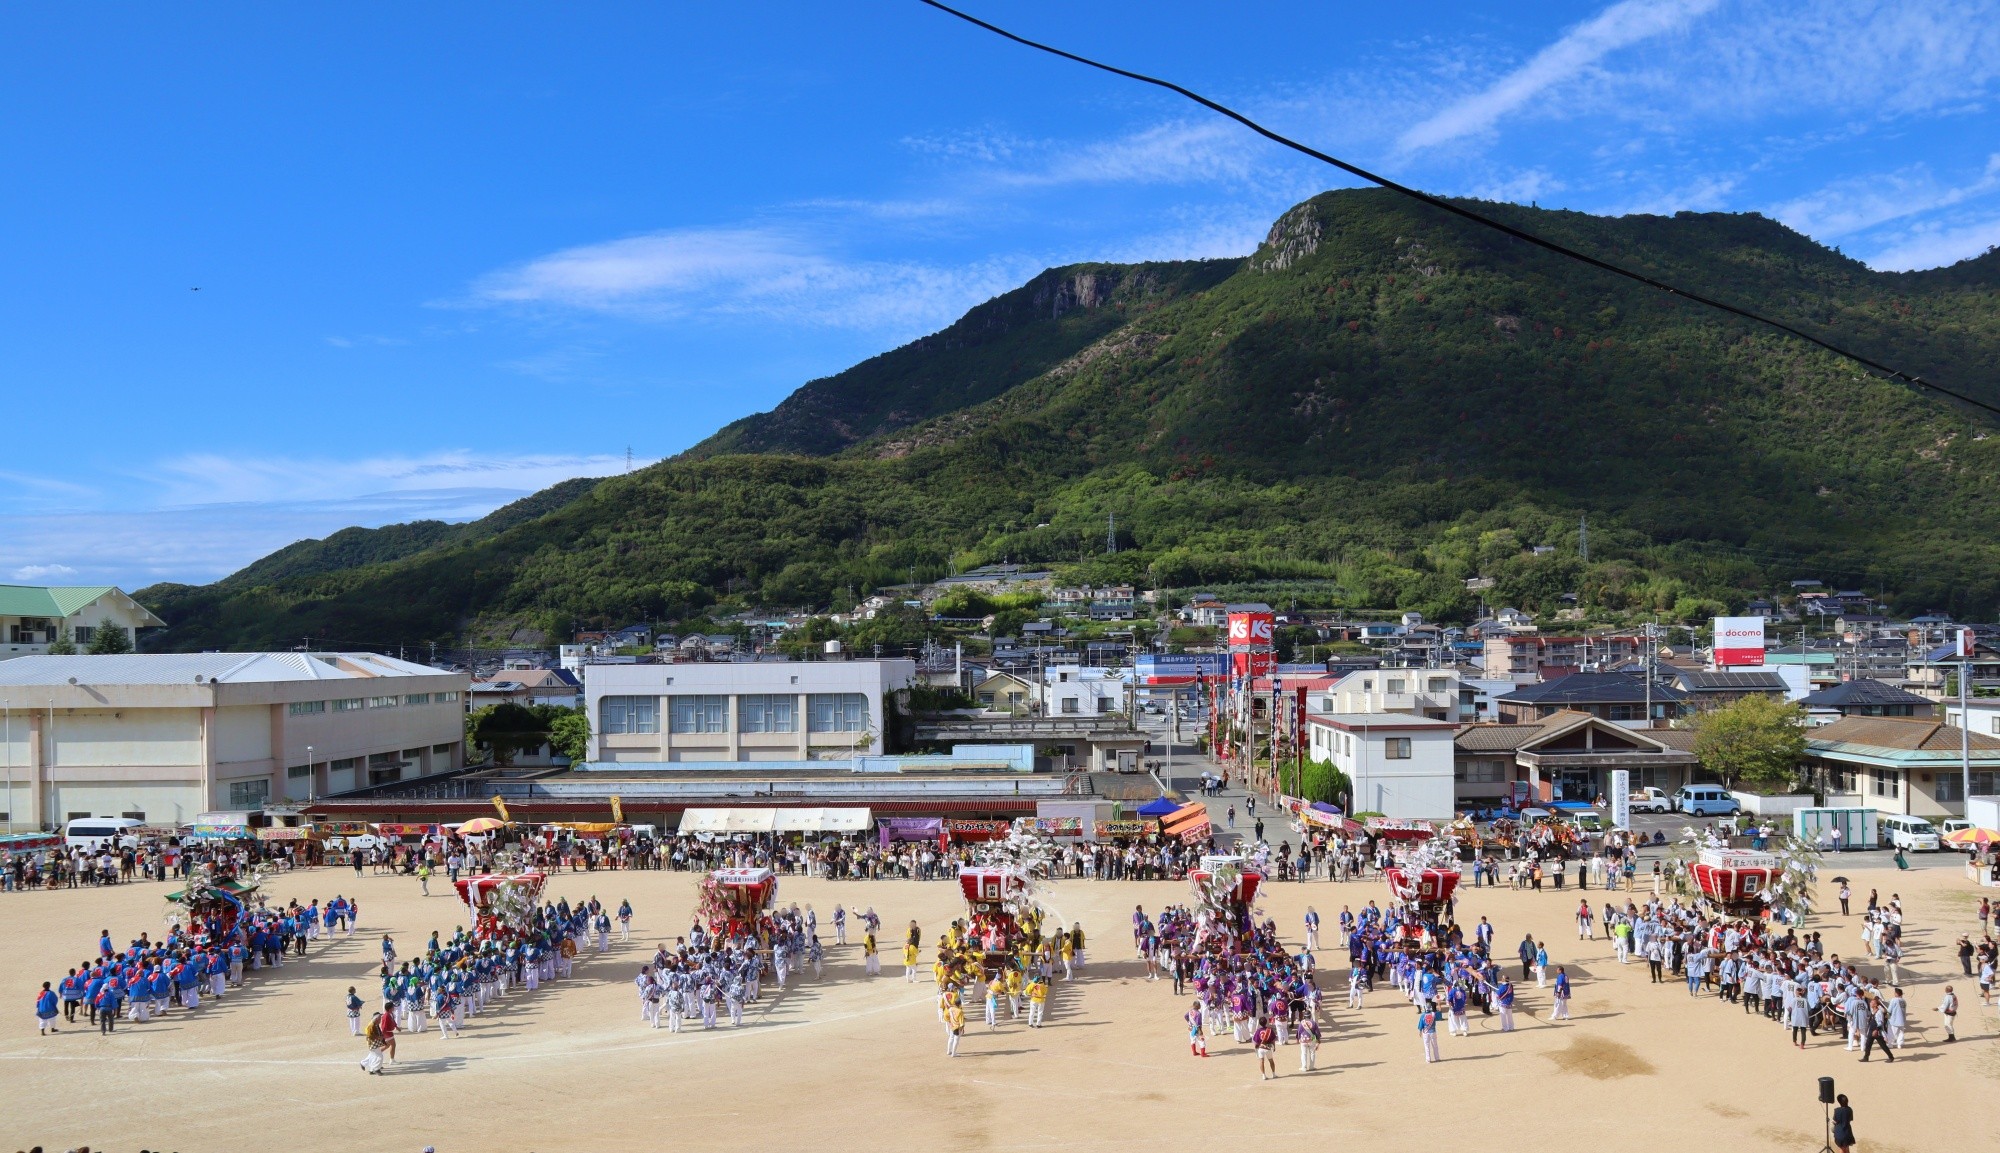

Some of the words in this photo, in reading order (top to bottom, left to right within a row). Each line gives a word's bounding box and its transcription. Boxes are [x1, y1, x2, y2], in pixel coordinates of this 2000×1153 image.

[1230, 618, 1247, 638] K's
[1251, 618, 1271, 638] K's
[1725, 629, 1762, 637] docomo
[955, 823, 996, 831] いかやき
